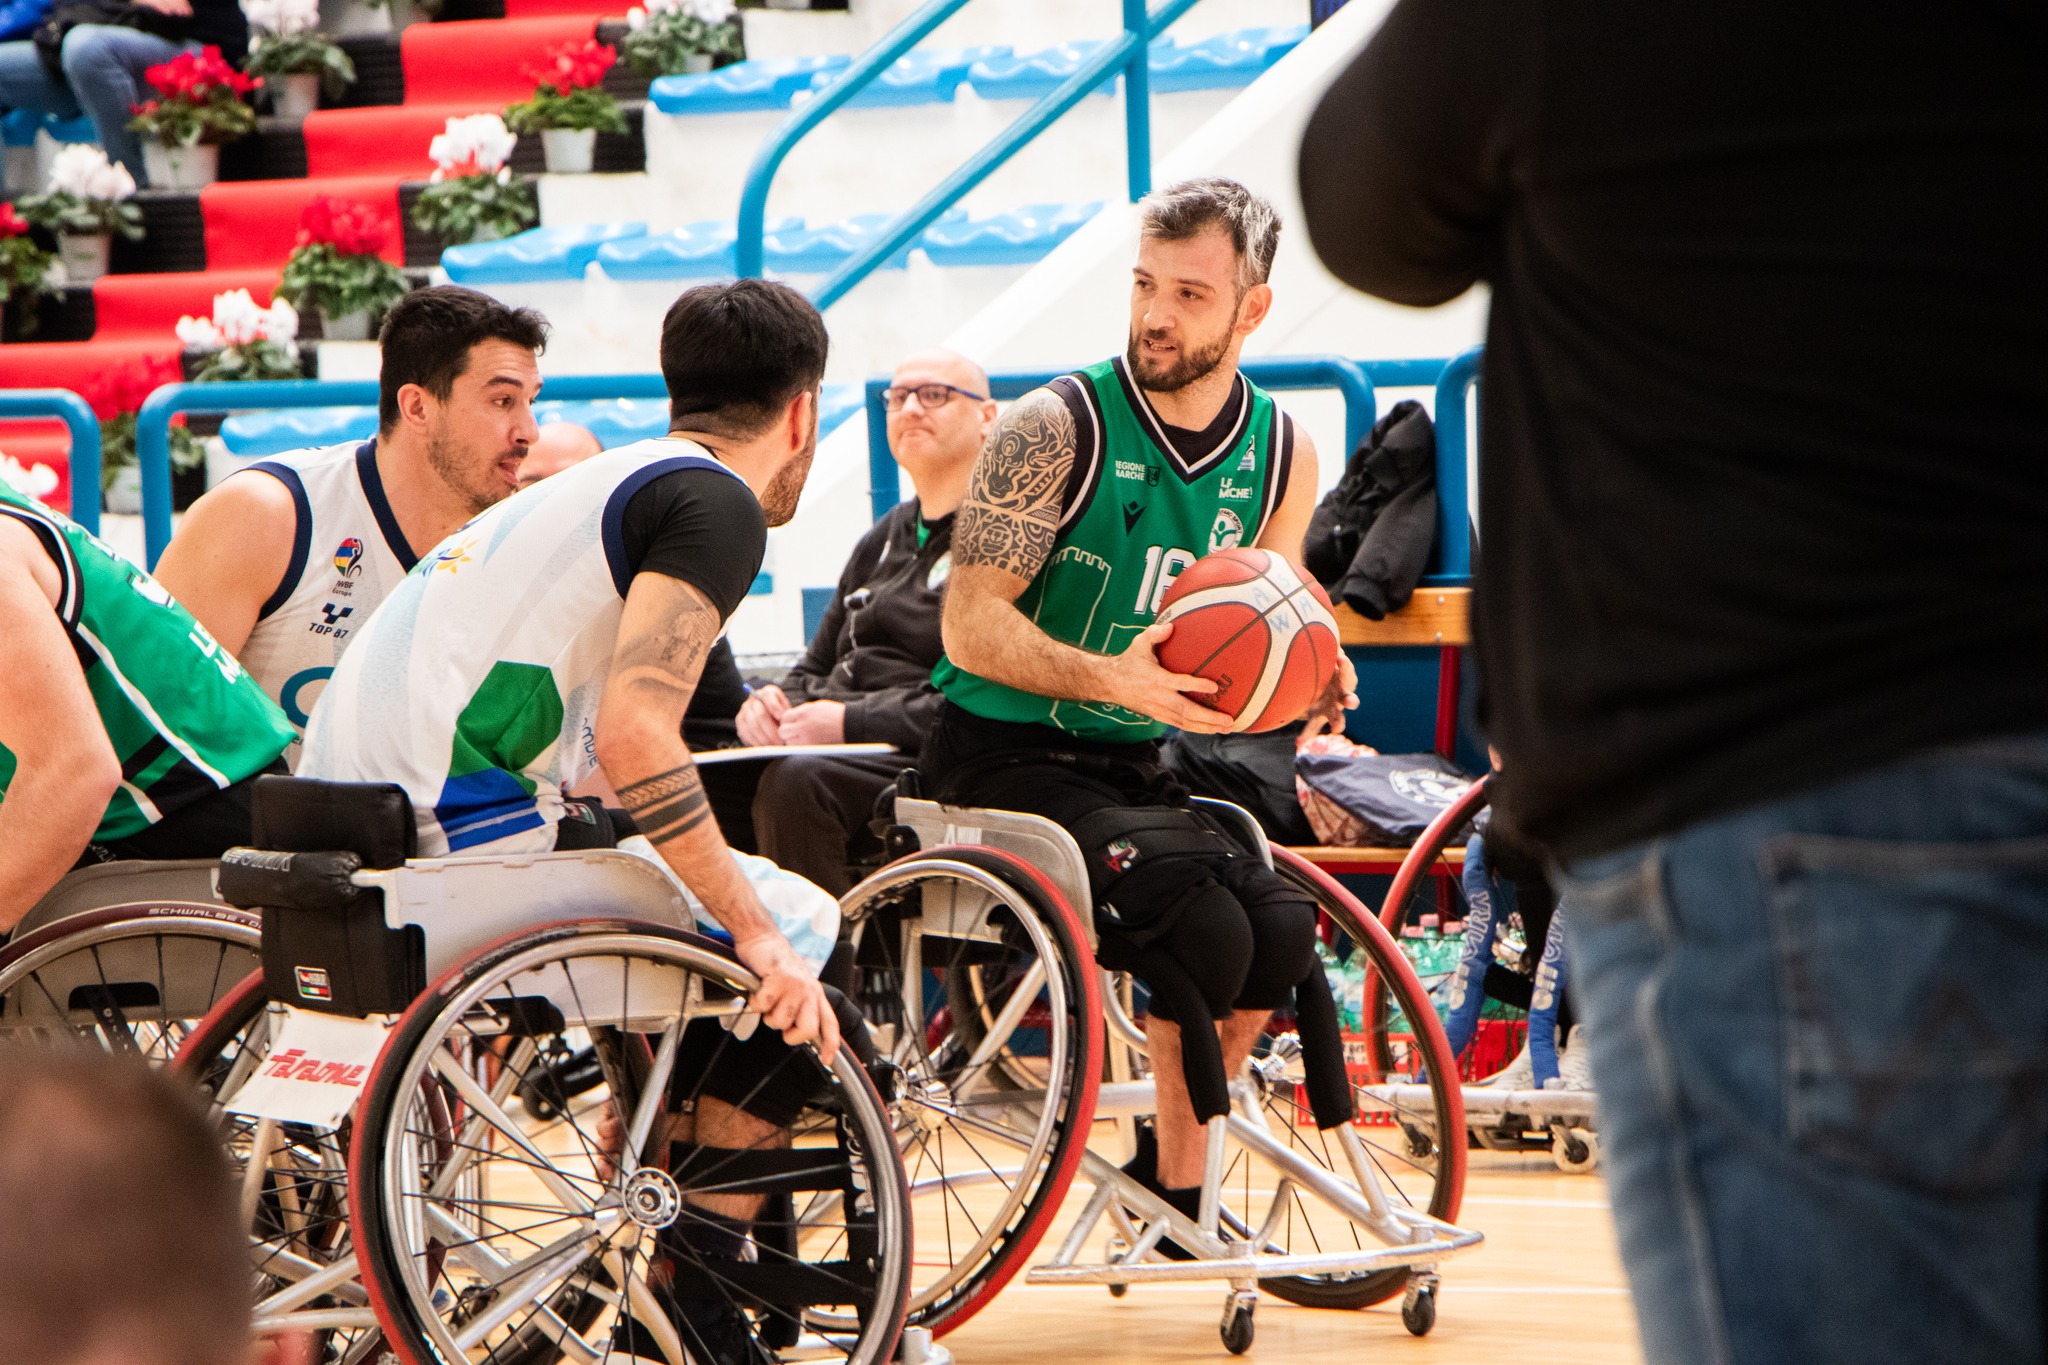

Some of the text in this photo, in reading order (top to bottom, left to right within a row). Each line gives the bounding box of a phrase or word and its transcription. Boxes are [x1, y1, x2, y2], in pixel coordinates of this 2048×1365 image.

[309, 622, 349, 639] TOP 87
[149, 907, 238, 921] SCHWALBE
